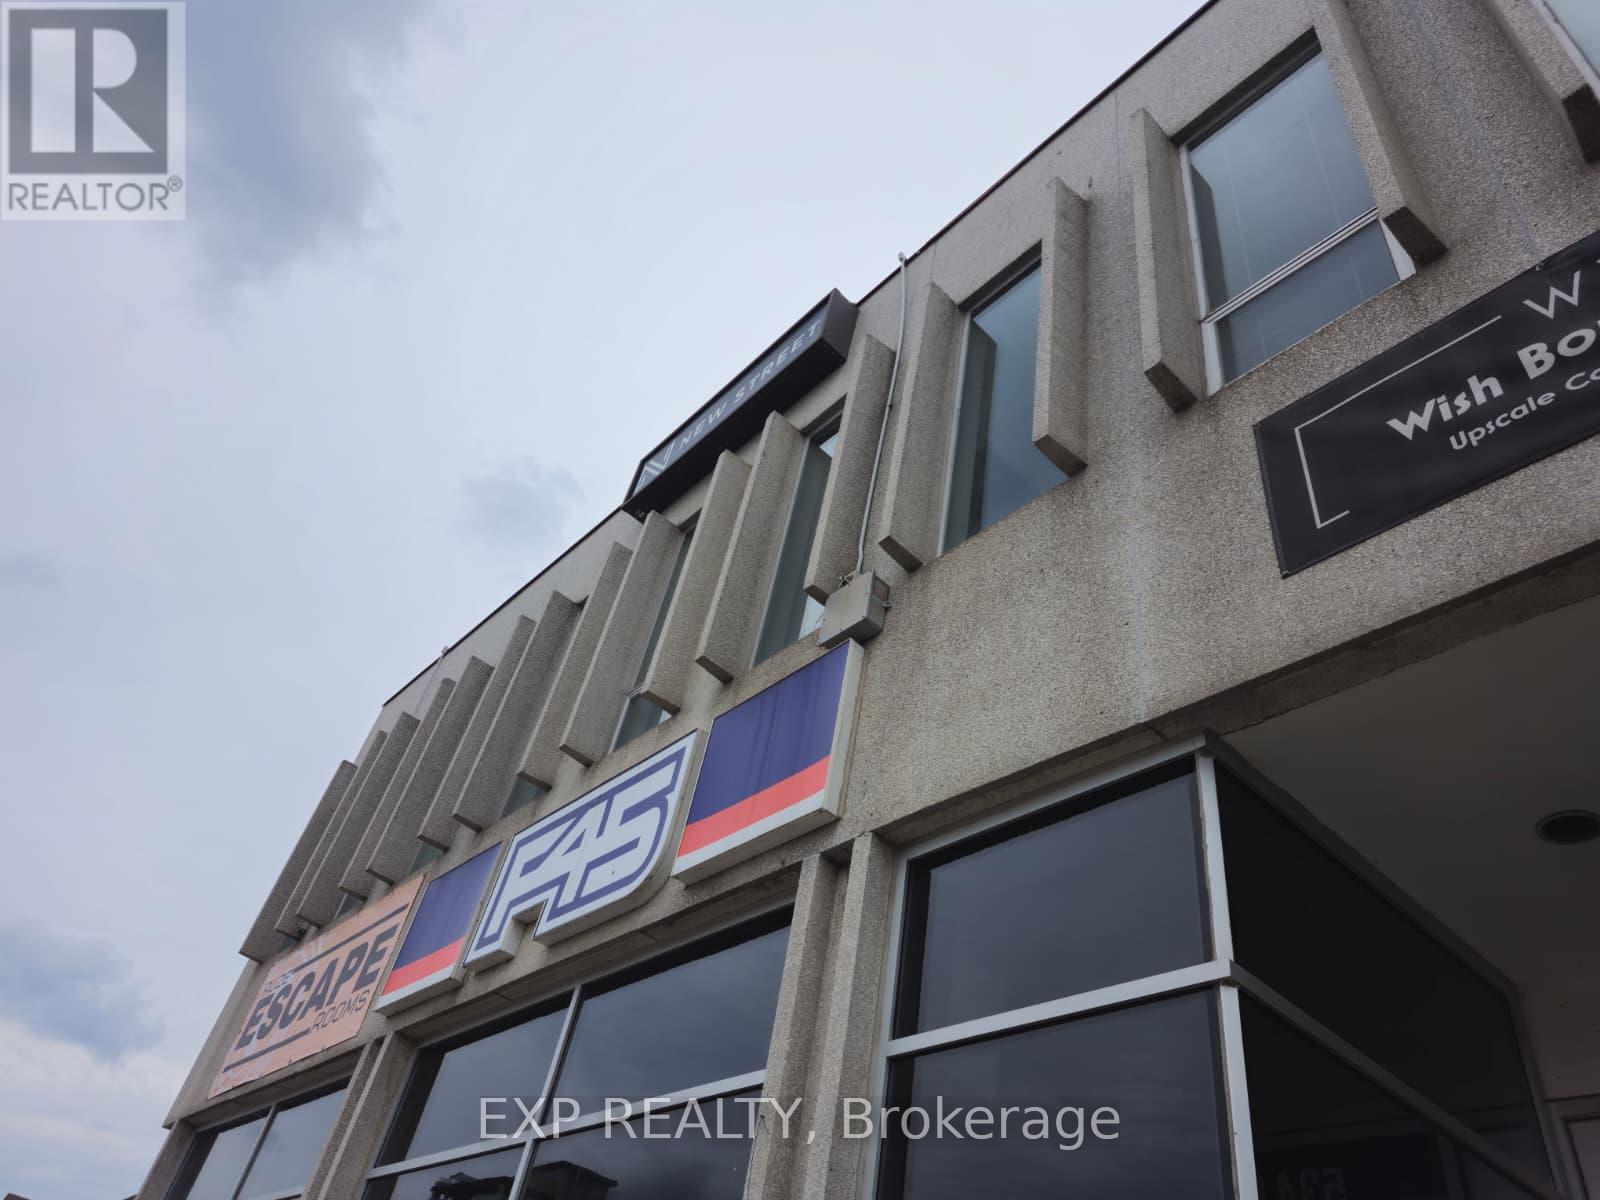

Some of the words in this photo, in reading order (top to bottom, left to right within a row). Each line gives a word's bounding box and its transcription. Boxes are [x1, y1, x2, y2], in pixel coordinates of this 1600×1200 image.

[678, 402, 728, 450] NEW
[734, 319, 821, 404] STREET
[1386, 375, 1505, 441] Wish
[1449, 392, 1556, 451] Upscale
[474, 745, 688, 951] F45
[235, 922, 400, 1051] ESCAPE
[310, 988, 371, 1034] ROOMS
